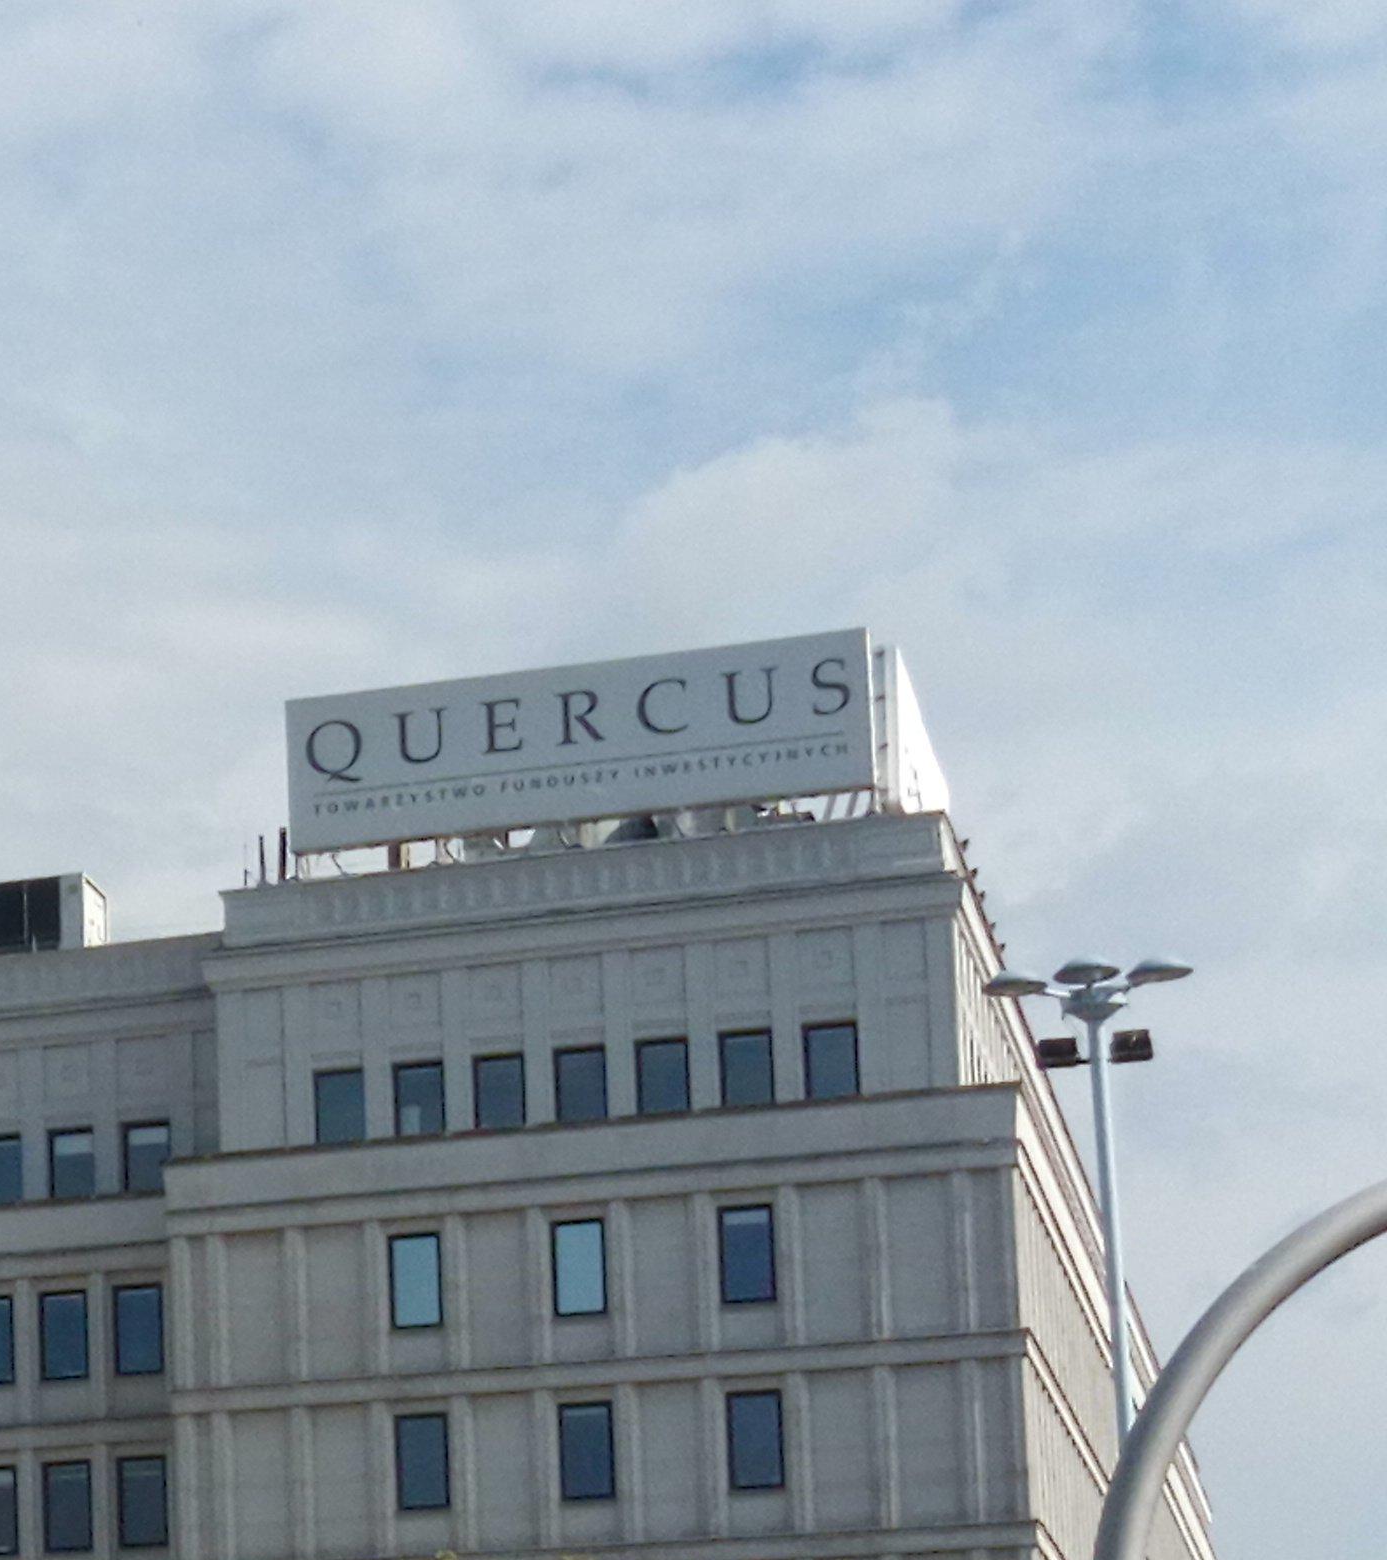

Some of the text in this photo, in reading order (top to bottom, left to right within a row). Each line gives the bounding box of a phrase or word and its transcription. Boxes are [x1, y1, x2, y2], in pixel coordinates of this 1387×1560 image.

[305, 656, 852, 782] QUERCUS
[312, 742, 849, 817] TOWARZYSTWO FUNDUSZY INWESTYCYJNYCH
